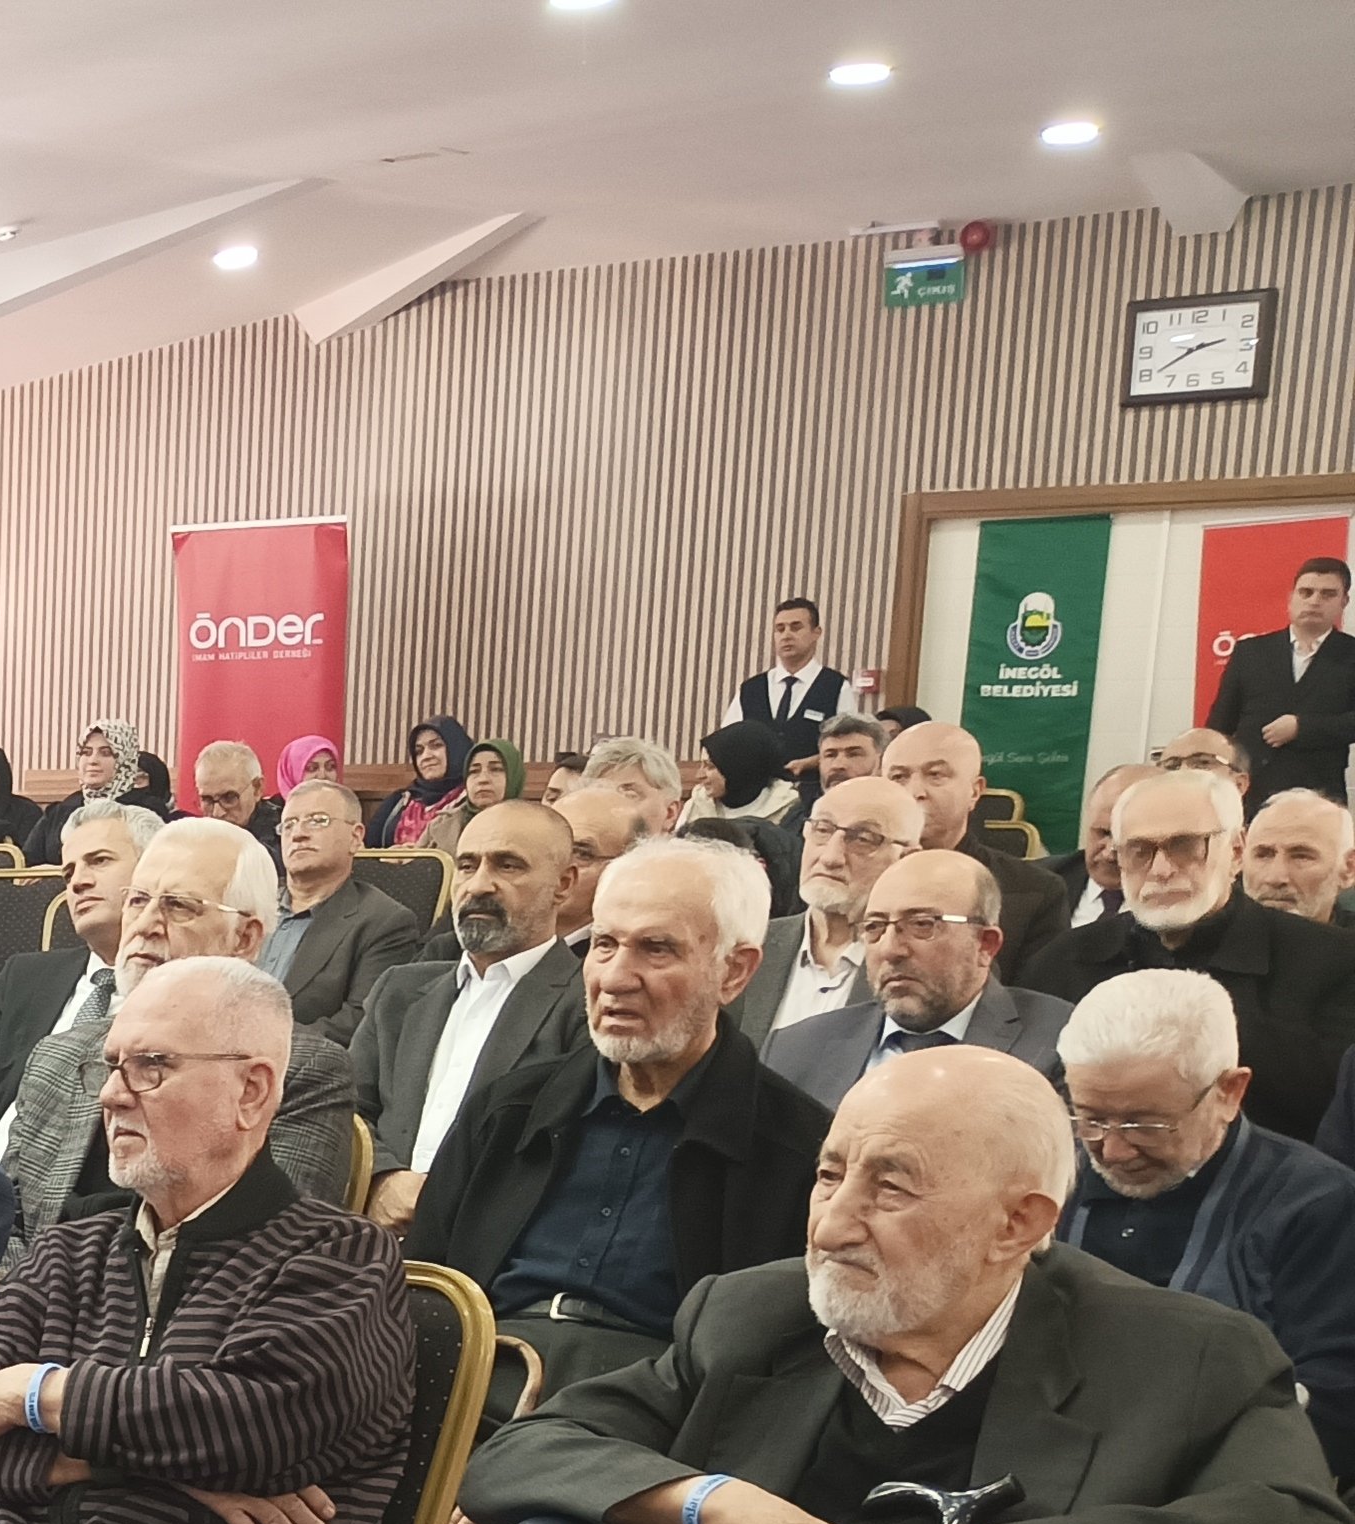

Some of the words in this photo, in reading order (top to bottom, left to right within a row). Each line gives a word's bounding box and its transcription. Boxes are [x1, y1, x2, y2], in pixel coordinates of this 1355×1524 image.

[1169, 313, 1182, 326] 11
[1191, 310, 1209, 324] 12
[1221, 309, 1227, 322] 1
[1241, 314, 1254, 328] 2
[1142, 321, 1158, 335] 10
[1239, 337, 1254, 352] 3
[1139, 346, 1153, 360] 9
[1235, 361, 1249, 374] 4
[1139, 369, 1153, 382] 8
[1165, 375, 1177, 388] 7
[1186, 373, 1200, 387] 6
[1211, 371, 1225, 385] 5
[998, 663, 1063, 680] İNEGÖL
[980, 680, 1079, 698] BELEDİYESİ
